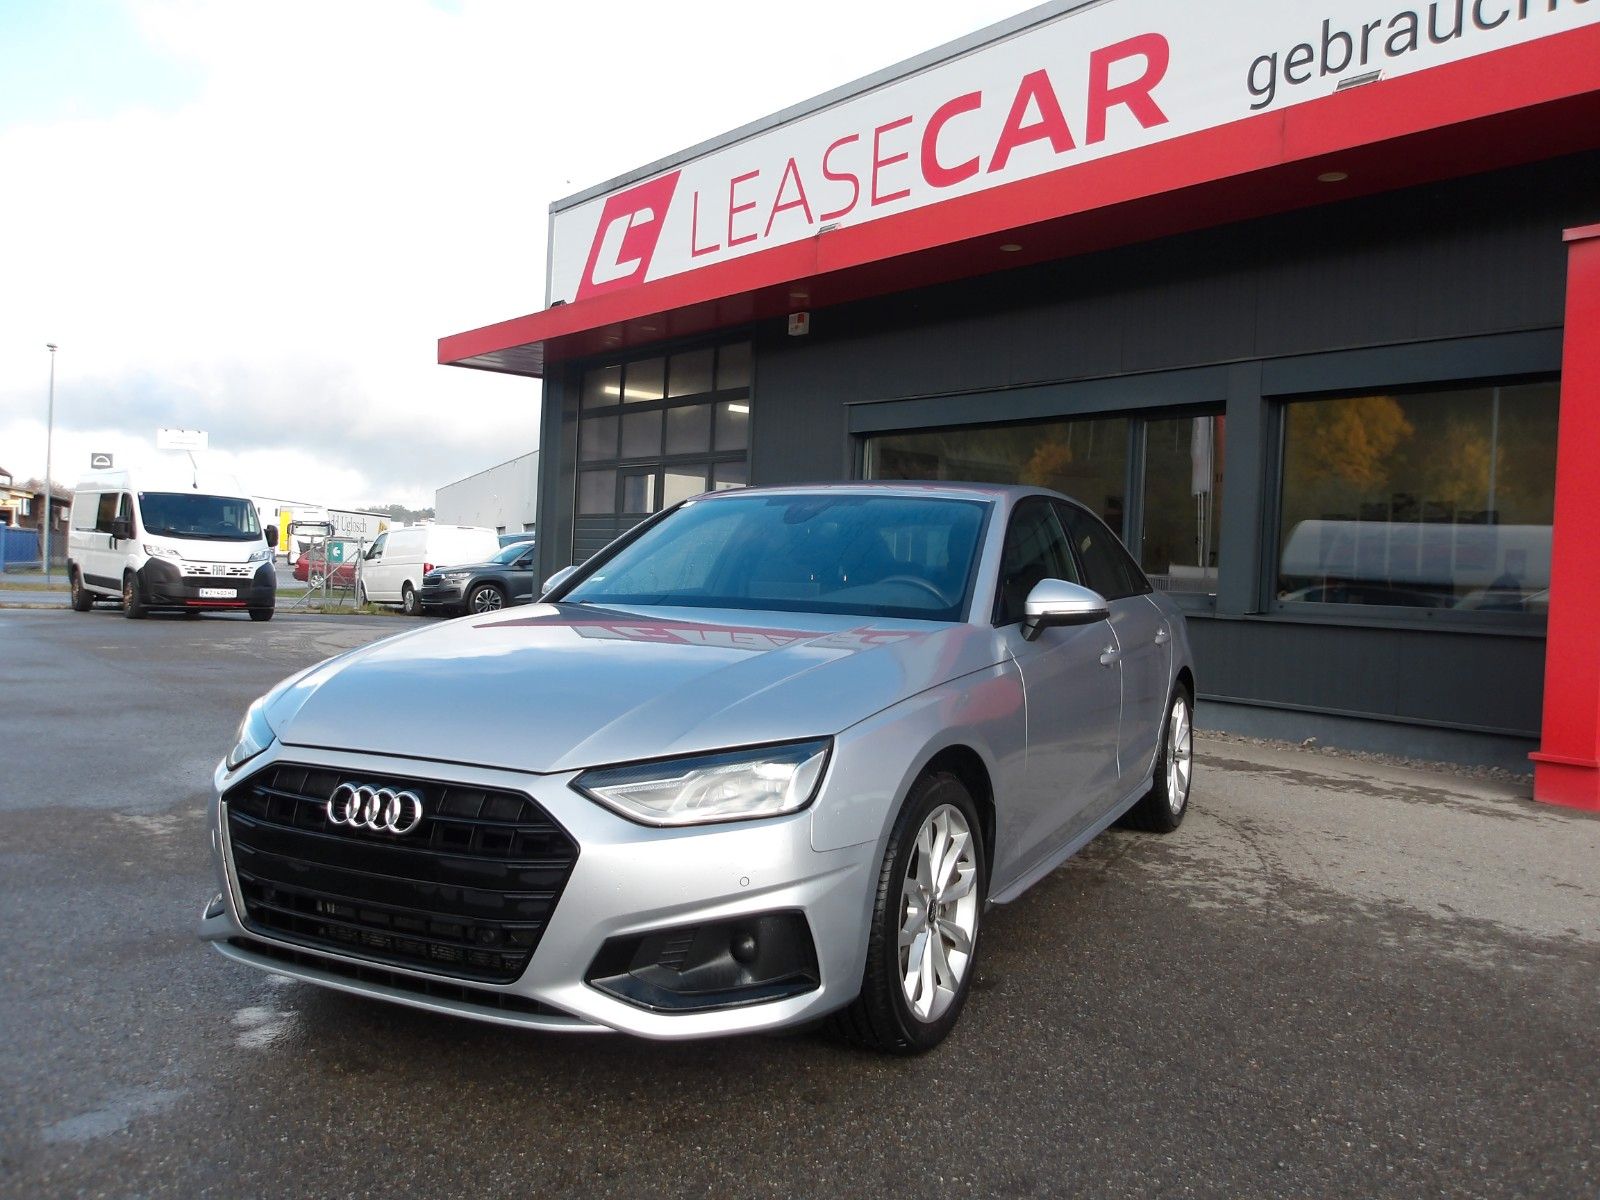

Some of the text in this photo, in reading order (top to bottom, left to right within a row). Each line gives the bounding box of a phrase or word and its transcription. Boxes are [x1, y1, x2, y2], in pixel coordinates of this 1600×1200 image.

[1246, 0, 1591, 110] gebrauc
[690, 32, 1170, 259] LEASECAR
[212, 564, 226, 576] FIAT
